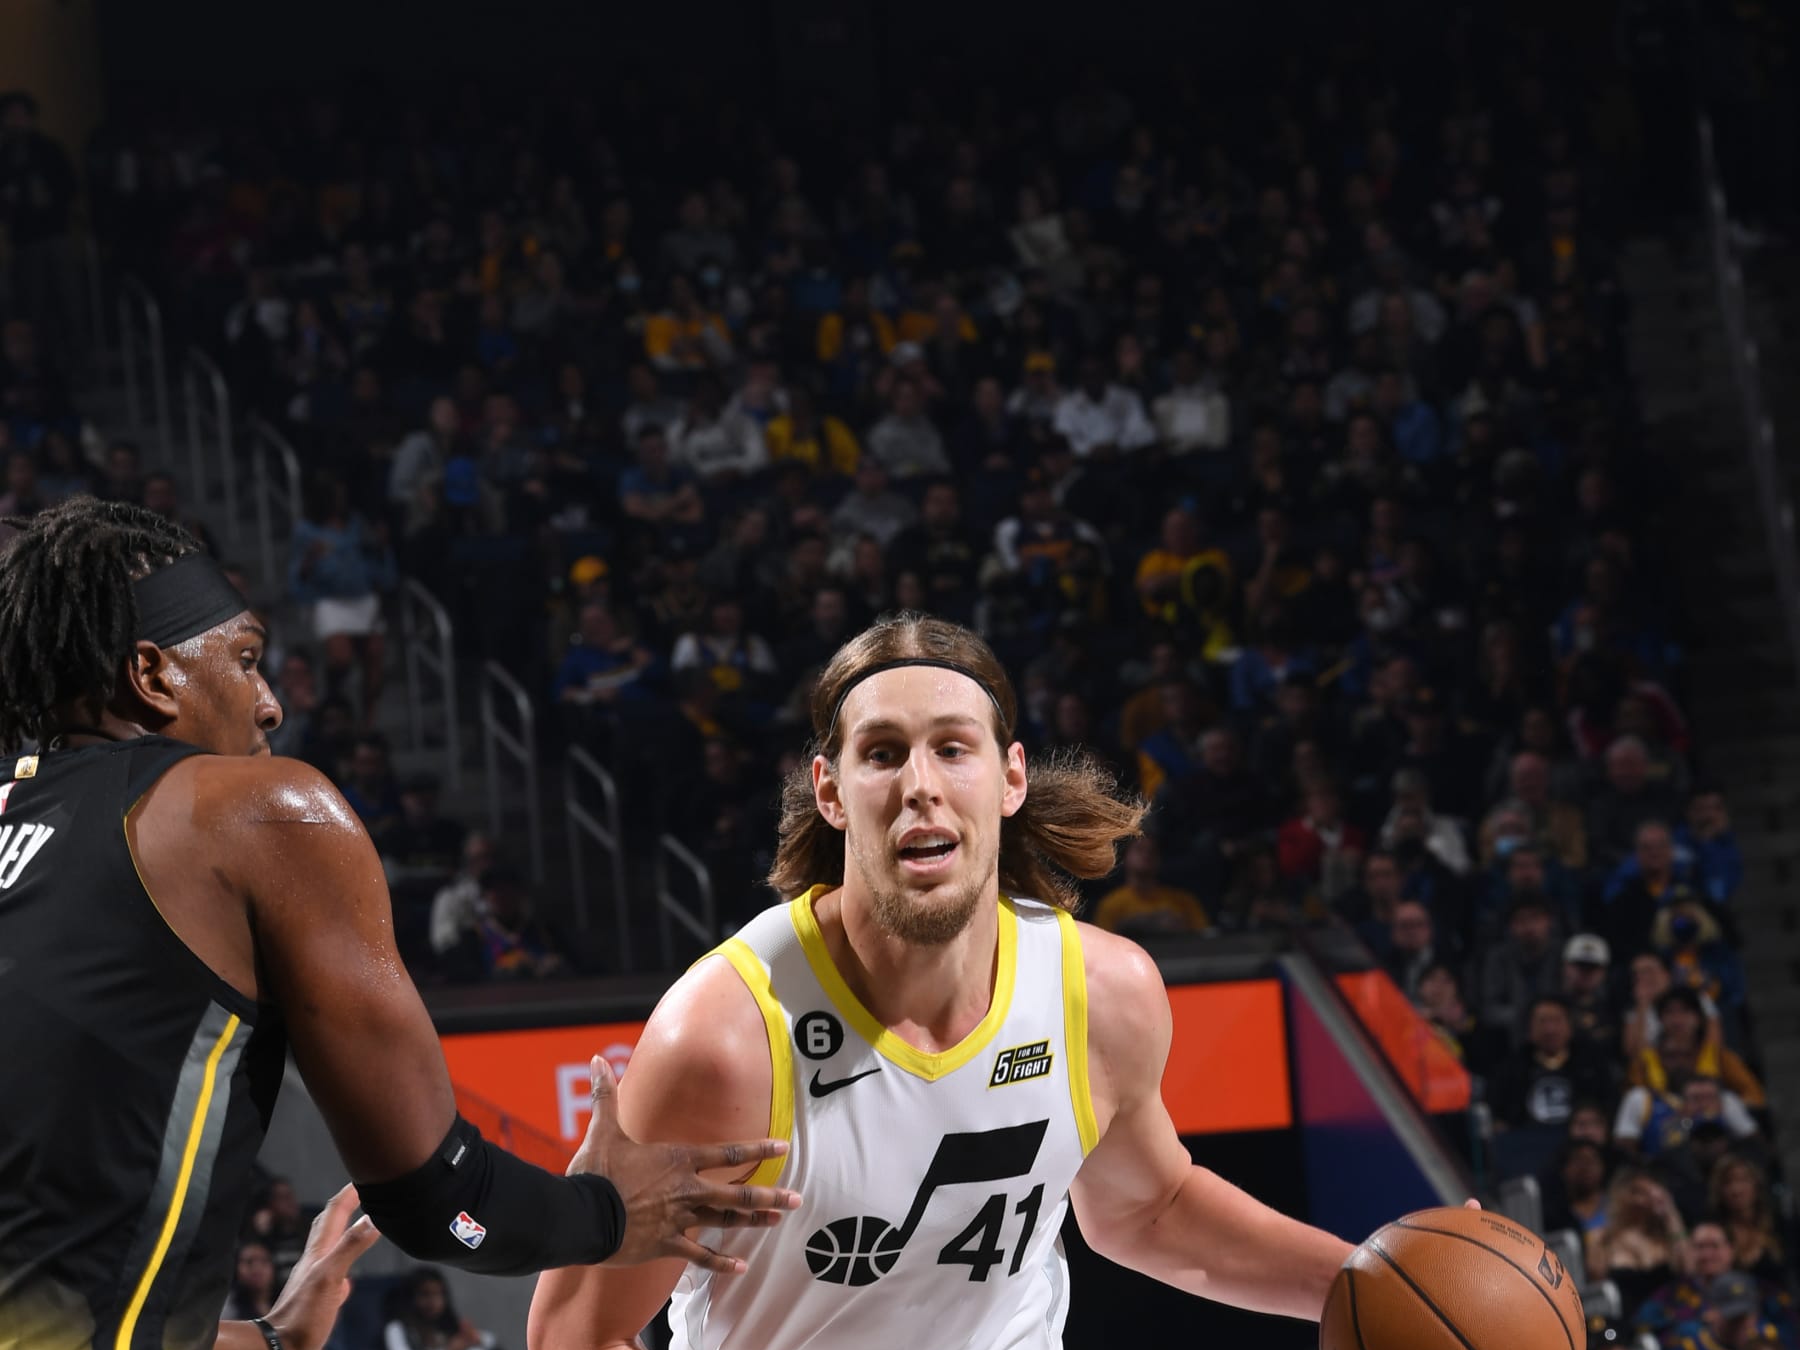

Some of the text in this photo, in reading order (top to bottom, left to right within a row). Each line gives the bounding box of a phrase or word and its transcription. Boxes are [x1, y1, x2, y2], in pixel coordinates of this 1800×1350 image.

[806, 1019, 831, 1054] 6
[1017, 1044, 1045, 1059] FOR THE
[994, 1052, 1011, 1083] 5
[1013, 1058, 1049, 1080] FIGHT
[936, 1183, 1045, 1282] 41
